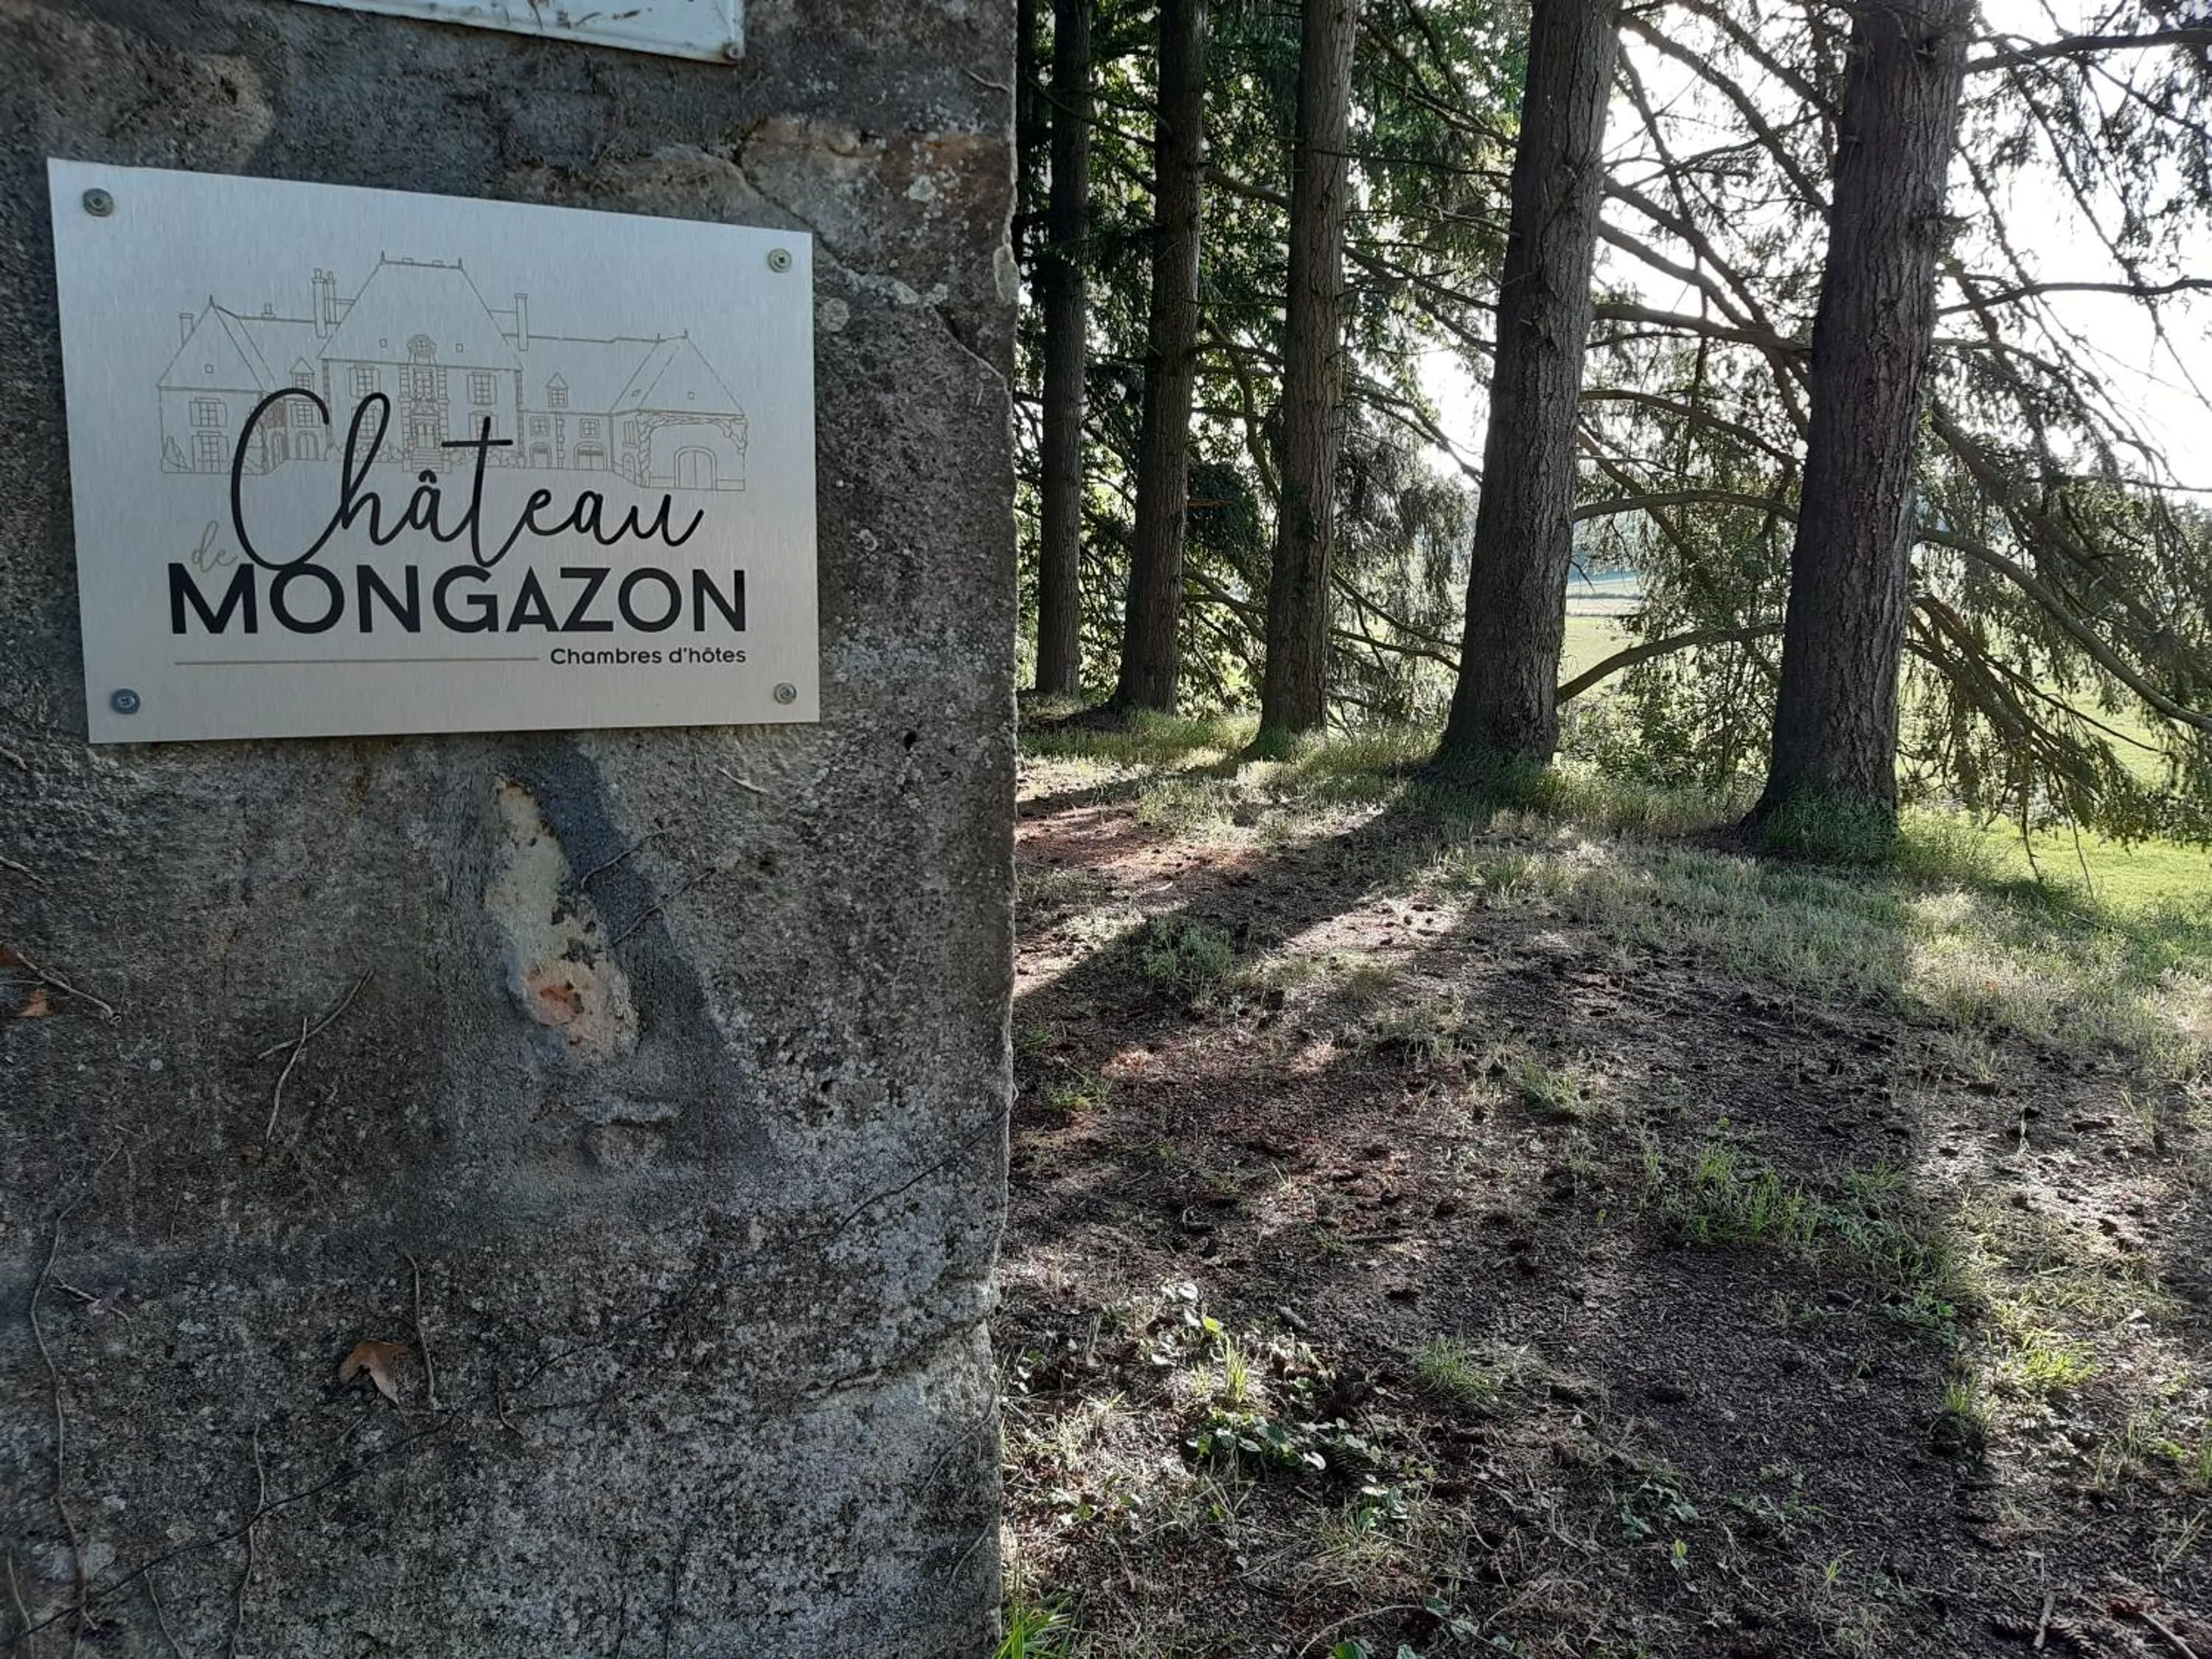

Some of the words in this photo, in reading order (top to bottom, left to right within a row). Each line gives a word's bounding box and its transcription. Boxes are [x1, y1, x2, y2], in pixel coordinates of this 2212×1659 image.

[231, 387, 704, 570] Château
[190, 521, 238, 573] de
[168, 563, 746, 634] MONGAZON
[551, 647, 662, 665] Chambres
[669, 647, 746, 665] d'hôtes
